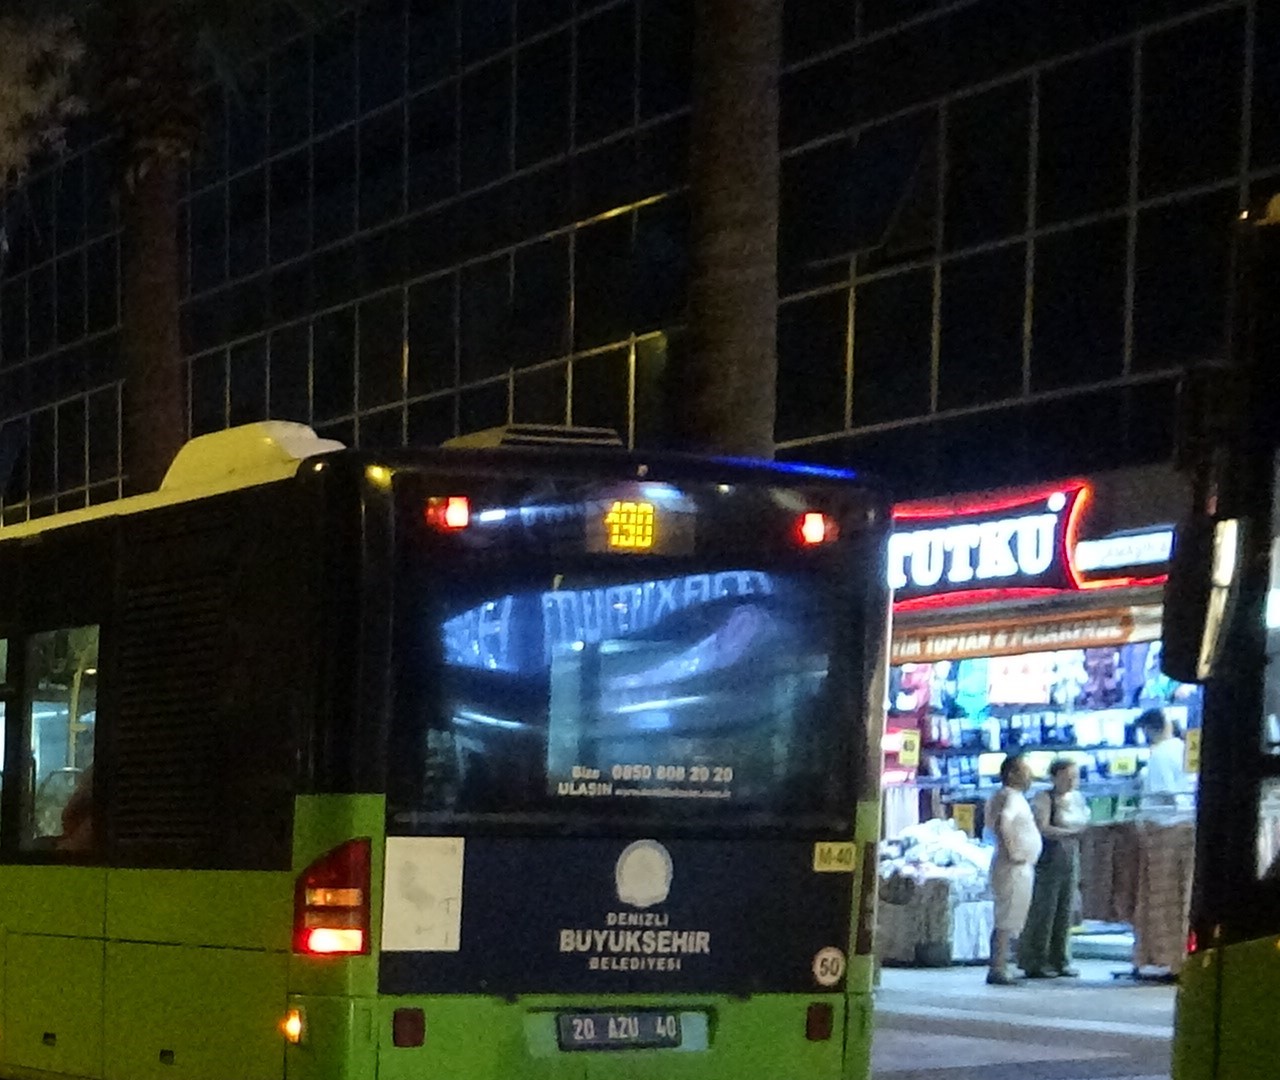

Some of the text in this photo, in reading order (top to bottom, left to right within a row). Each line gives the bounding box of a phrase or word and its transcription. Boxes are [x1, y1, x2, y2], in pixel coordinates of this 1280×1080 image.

[611, 764, 652, 781] 0850
[819, 957, 840, 977] 50
[571, 1017, 595, 1041] 20
[655, 1015, 677, 1038] 40
